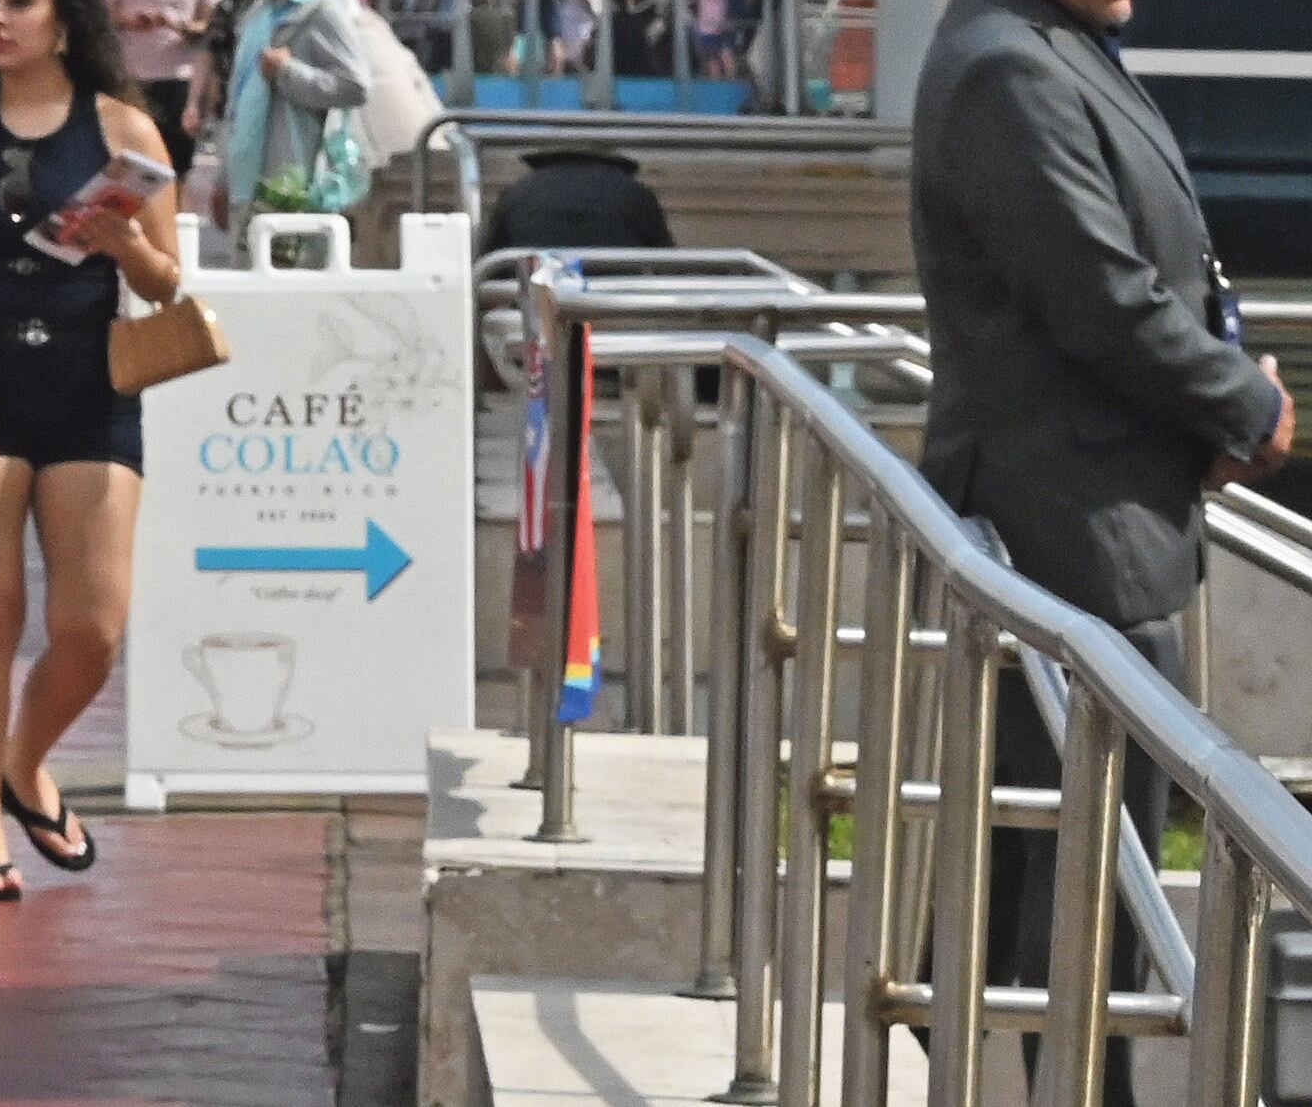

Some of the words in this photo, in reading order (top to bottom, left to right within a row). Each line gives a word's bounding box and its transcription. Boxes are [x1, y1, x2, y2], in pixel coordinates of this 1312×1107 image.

[225, 383, 365, 426] CAFÉ
[198, 483, 296, 498] PUERTO
[323, 483, 399, 498] RICO
